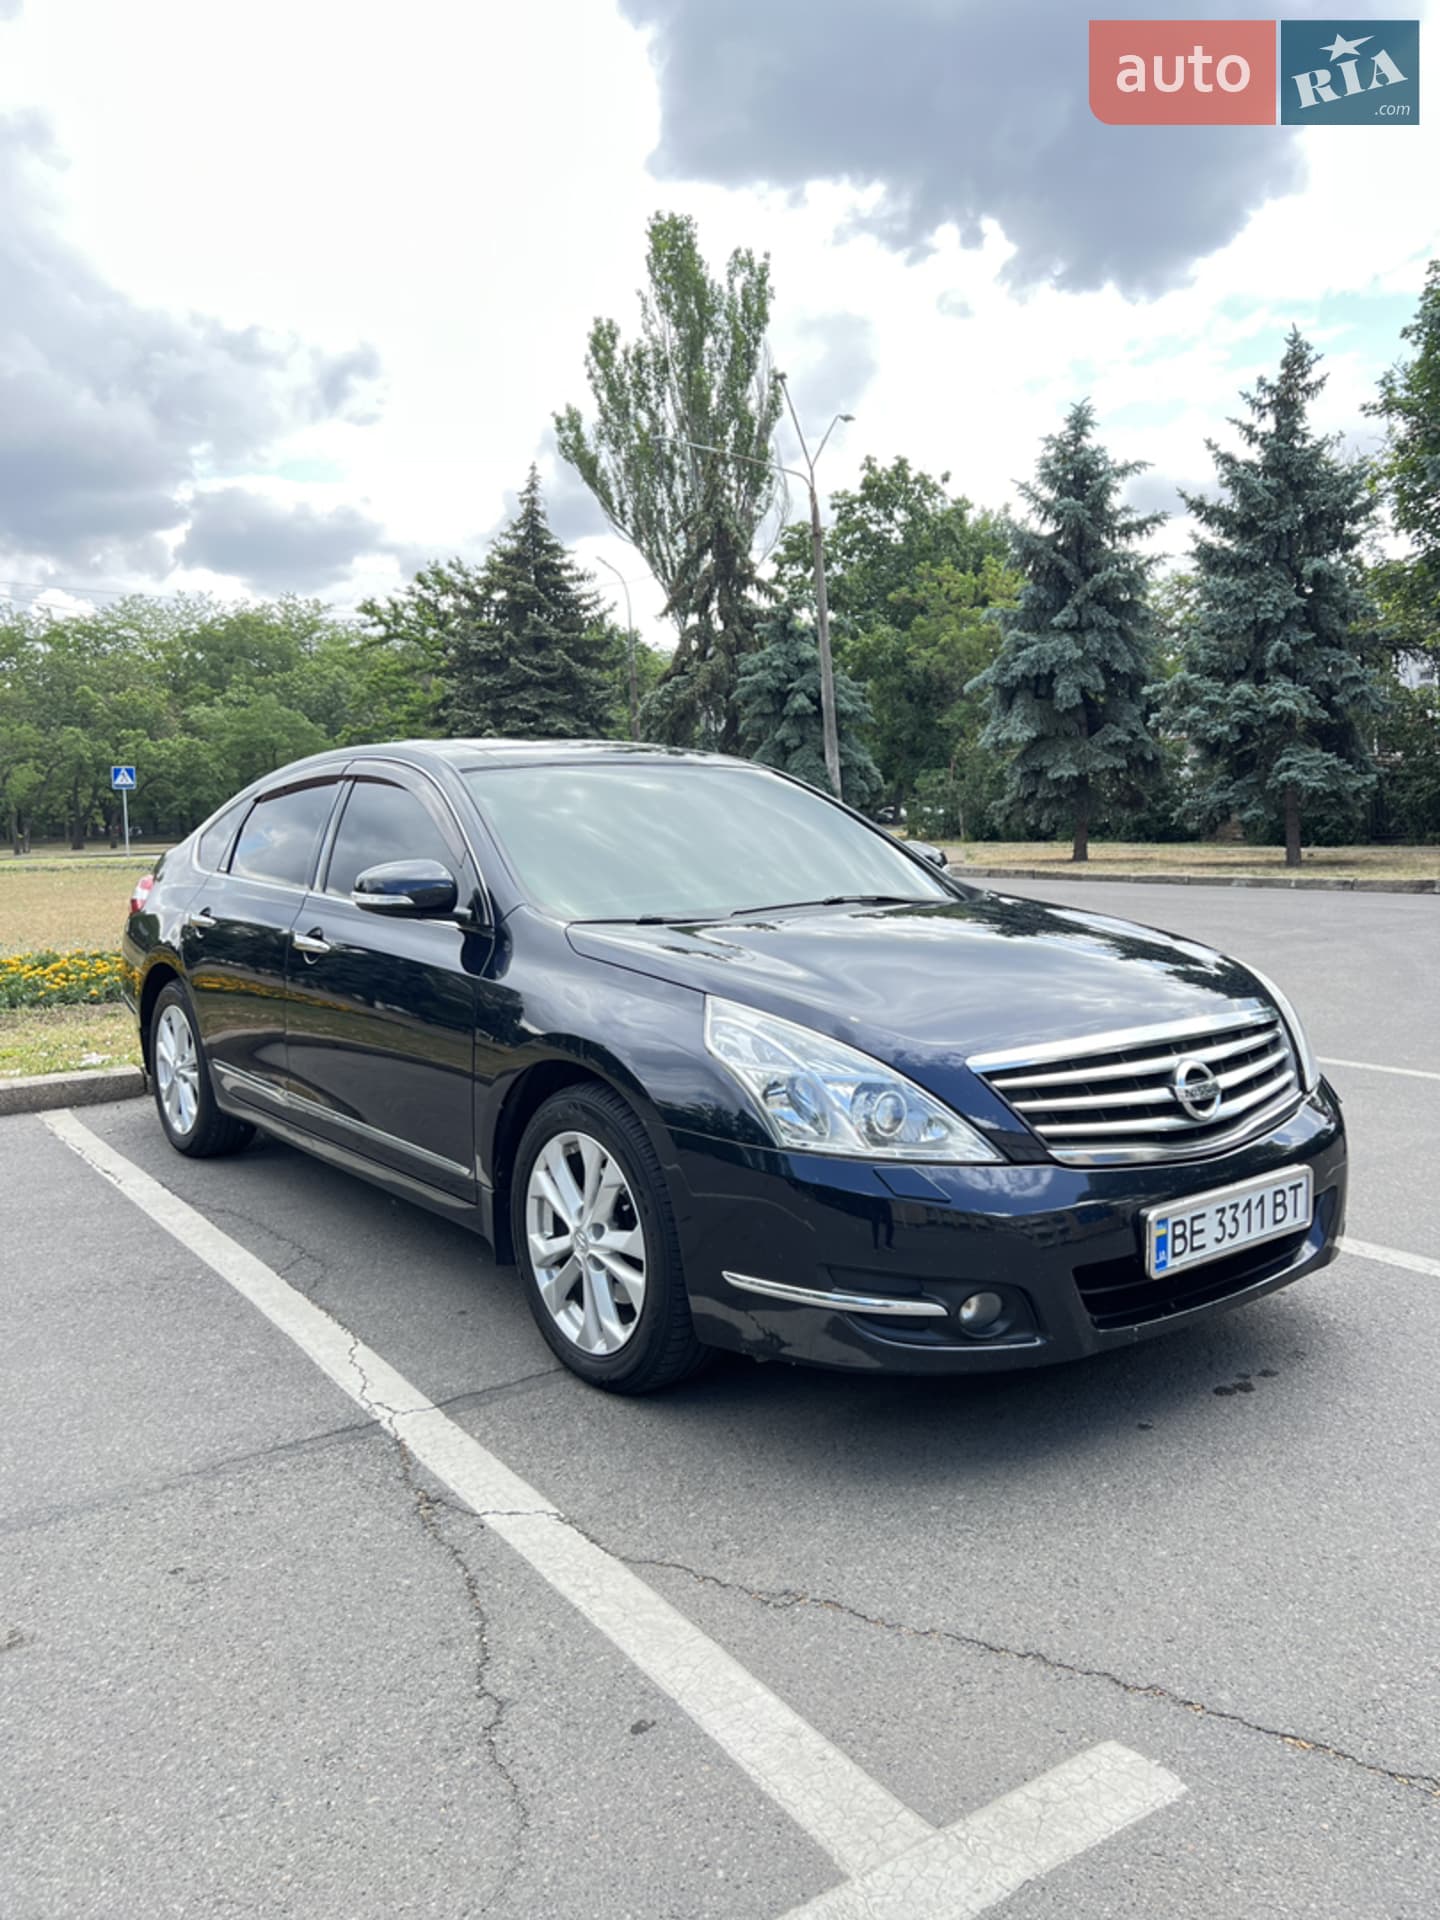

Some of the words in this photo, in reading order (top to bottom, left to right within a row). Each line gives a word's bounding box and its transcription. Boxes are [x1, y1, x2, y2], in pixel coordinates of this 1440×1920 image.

[1172, 1213, 1206, 1259] BE
[1214, 1194, 1265, 1244] 3311
[1272, 1182, 1303, 1226] BT
